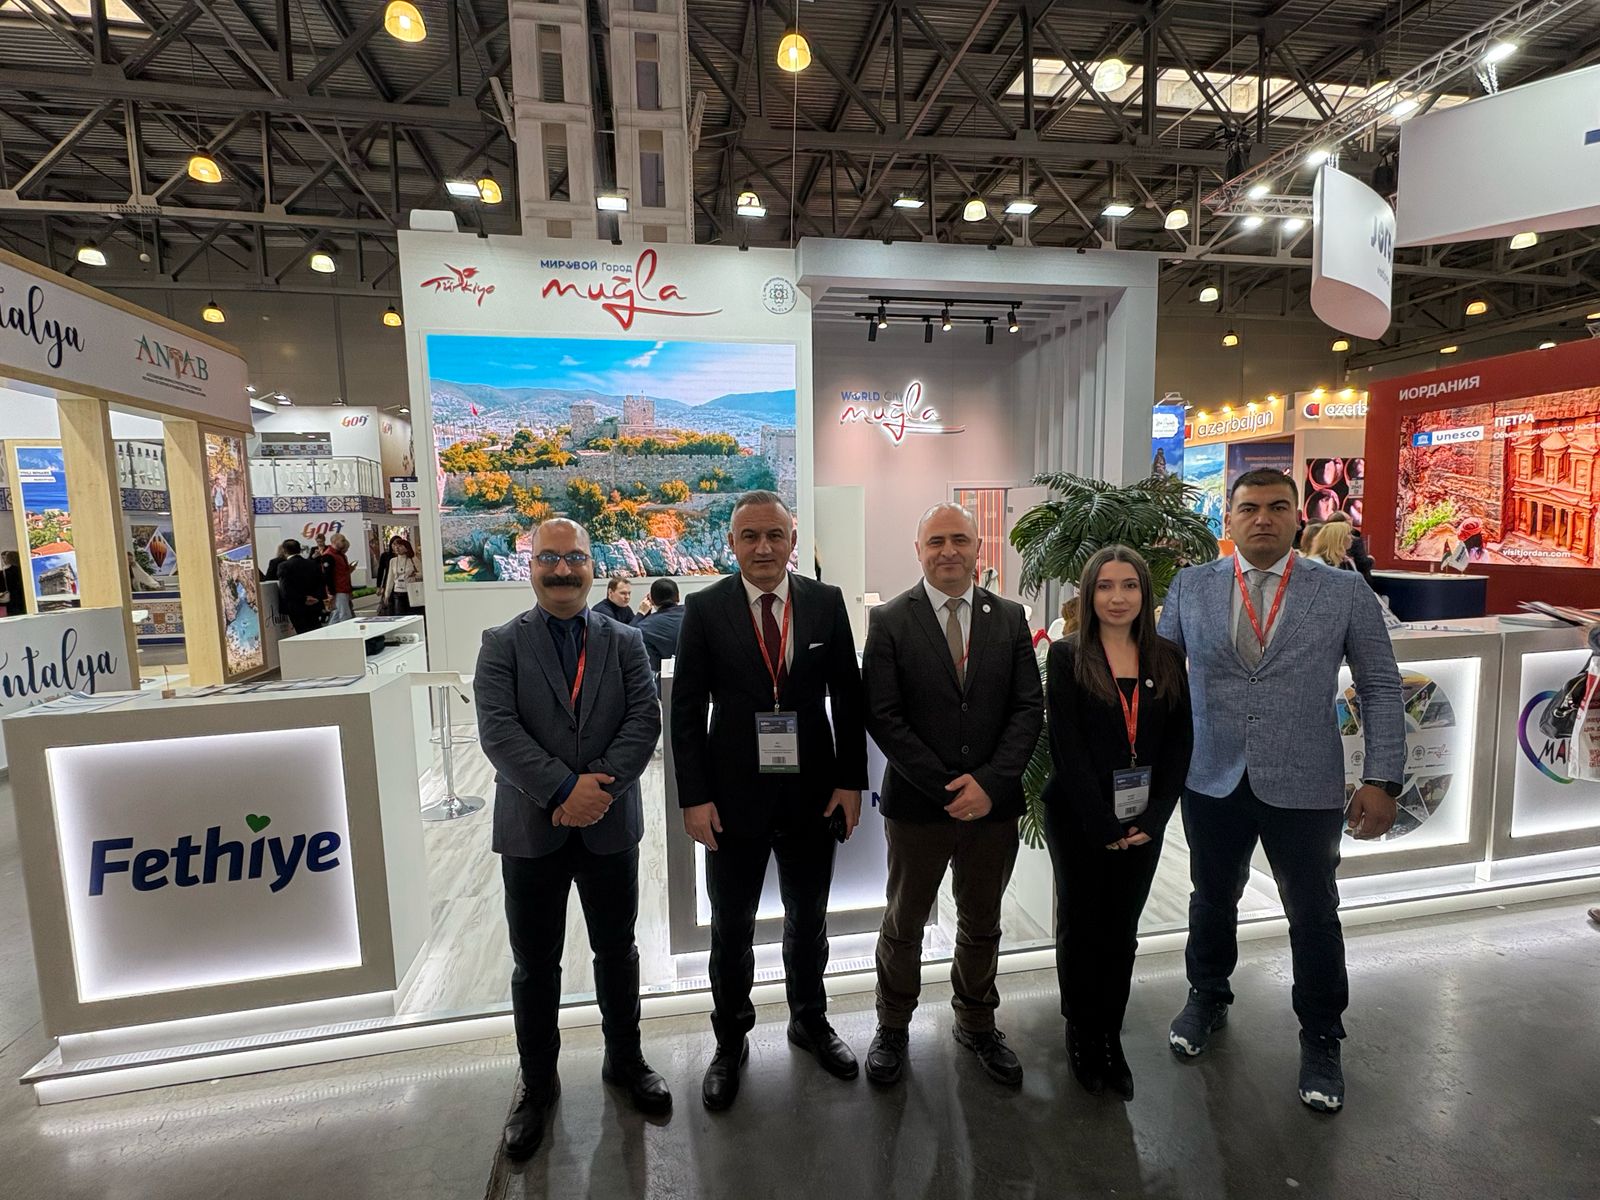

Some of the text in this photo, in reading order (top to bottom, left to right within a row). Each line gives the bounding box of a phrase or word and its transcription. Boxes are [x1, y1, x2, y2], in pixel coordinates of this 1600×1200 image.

[602, 262, 633, 273] Город
[420, 266, 496, 307] Türkiye
[0, 285, 85, 369] alya
[1399, 375, 1480, 401] ИОРДАНИЯ
[1198, 409, 1275, 437] azerbaijan
[1494, 413, 1535, 428] ПЕТРА
[1436, 430, 1480, 441] unesco
[395, 490, 416, 498] 2033
[401, 483, 409, 491] B
[1502, 548, 1571, 558] visitjordan.com
[0, 628, 118, 696] ntalya
[89, 819, 342, 897] Fethiye
